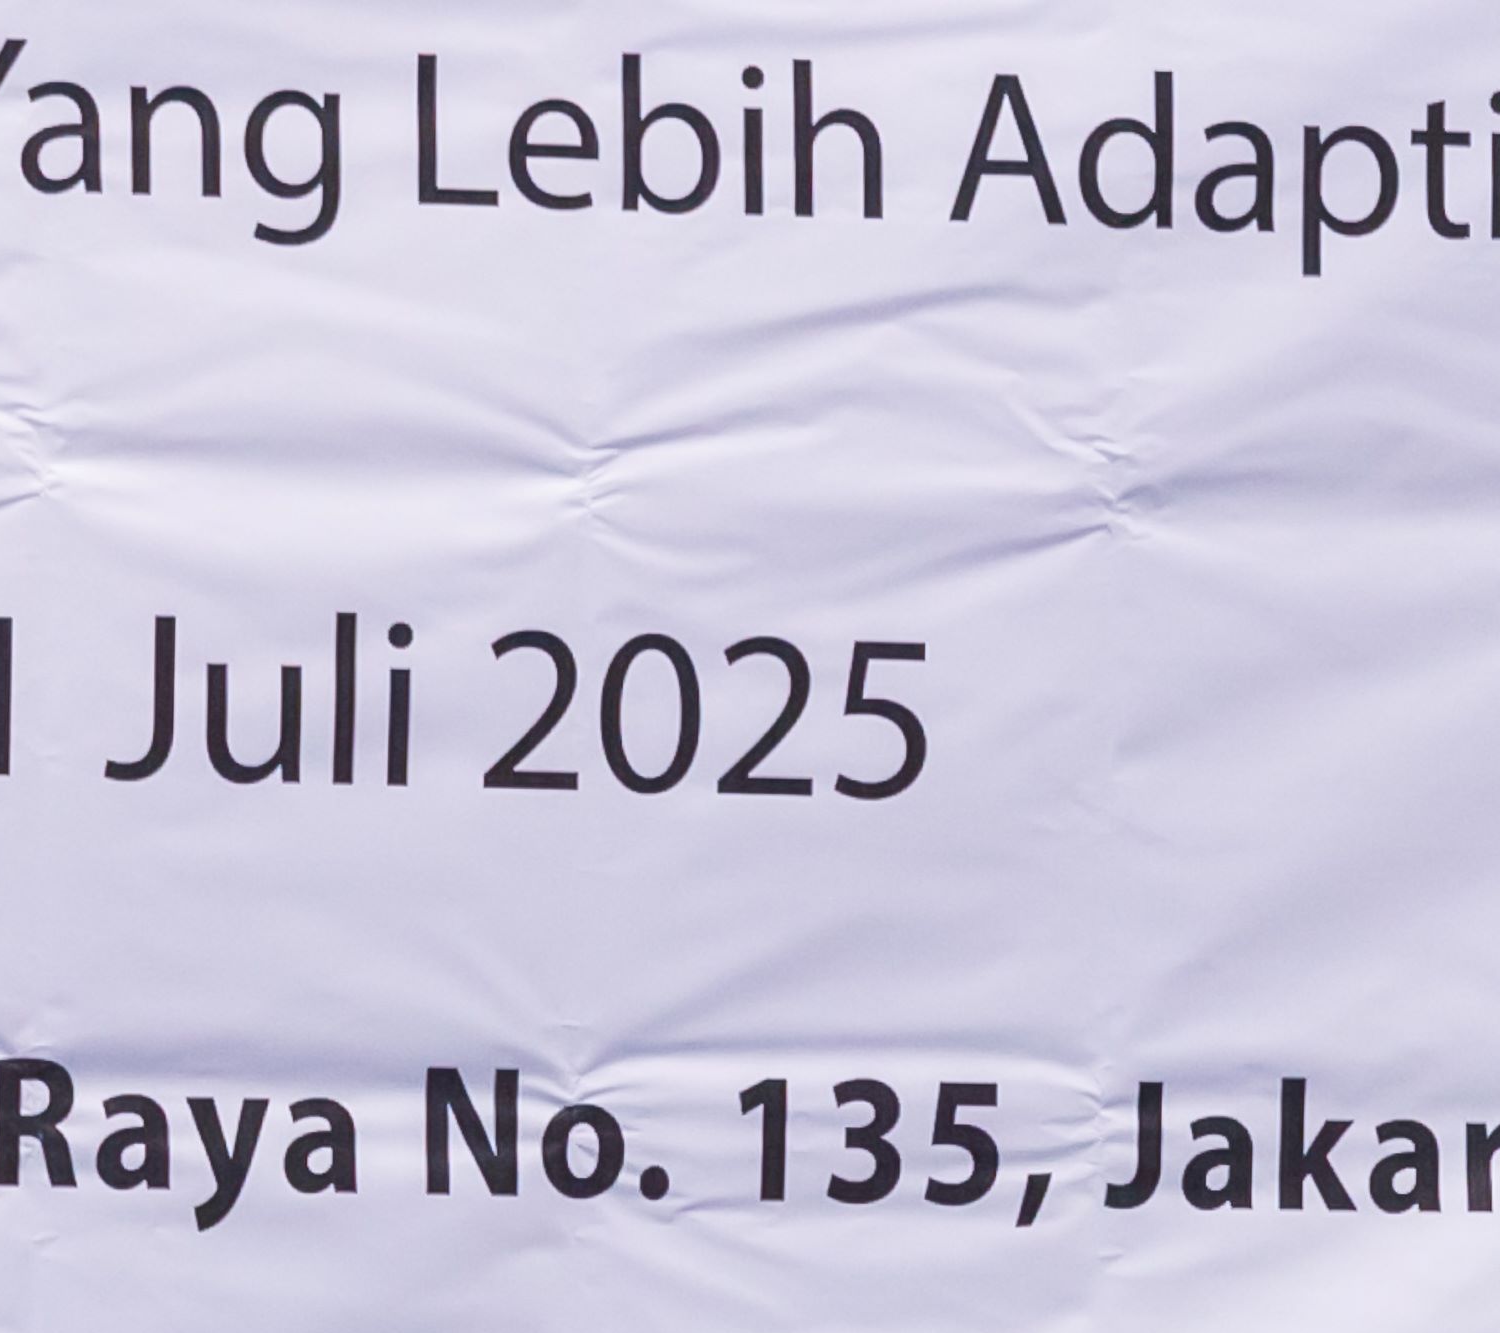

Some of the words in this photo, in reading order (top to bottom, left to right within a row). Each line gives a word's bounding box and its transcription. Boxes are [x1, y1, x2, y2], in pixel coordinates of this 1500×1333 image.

[417, 53, 883, 219] Lebih
[104, 612, 413, 786] Juli
[483, 630, 927, 800] 2025
[425, 1066, 670, 1201] No.
[739, 1078, 1051, 1227] 135,
